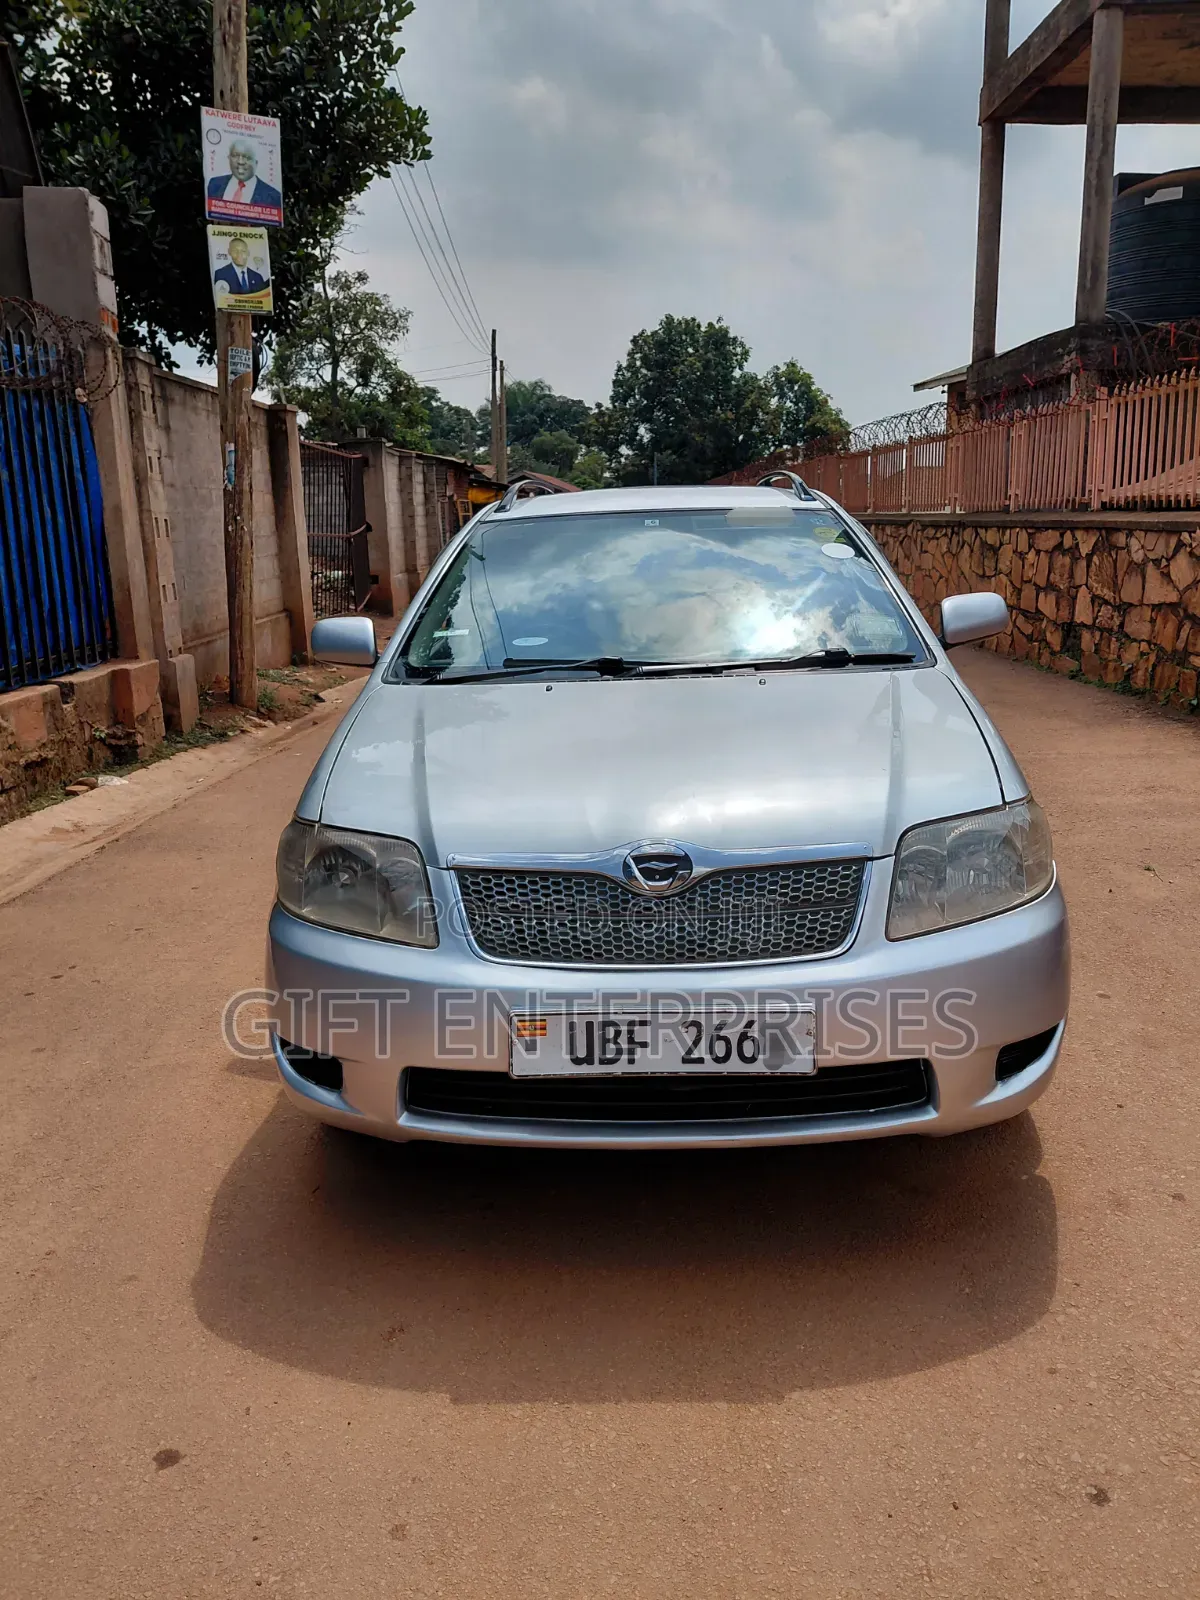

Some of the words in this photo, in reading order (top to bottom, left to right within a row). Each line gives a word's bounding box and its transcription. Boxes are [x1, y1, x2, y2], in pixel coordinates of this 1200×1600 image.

[205, 108, 242, 121] KATWERE
[243, 115, 277, 128] LUTAAYA
[226, 121, 257, 132] GODFREY
[226, 202, 262, 213] COUNCILLOR
[239, 232, 264, 240] ENOCK
[568, 1019, 652, 1066] UBF
[680, 1019, 786, 1067] 266
